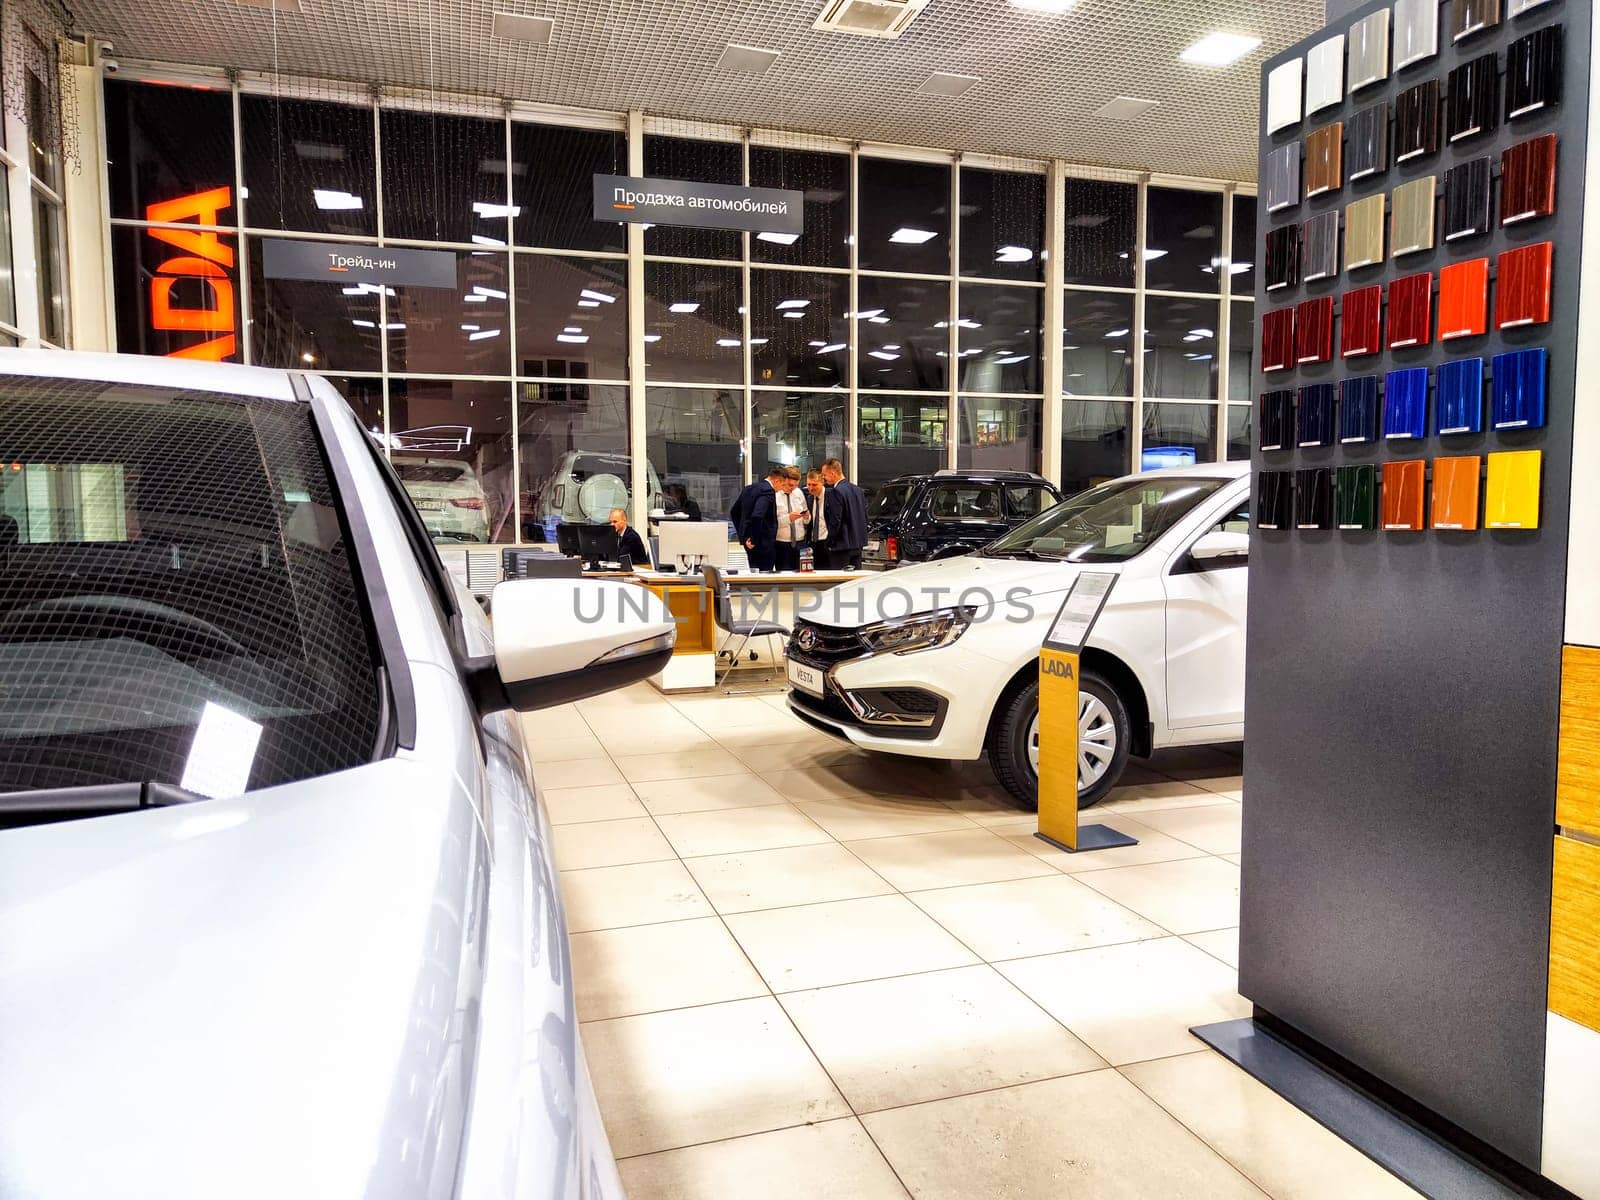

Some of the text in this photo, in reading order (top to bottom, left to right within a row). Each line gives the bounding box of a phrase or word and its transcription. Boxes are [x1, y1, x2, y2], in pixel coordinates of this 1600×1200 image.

[613, 188, 788, 214] Продажа автомобилей
[328, 253, 396, 269] Трейд-ин
[796, 665, 814, 685] VESTA
[1041, 657, 1074, 680] LADA
